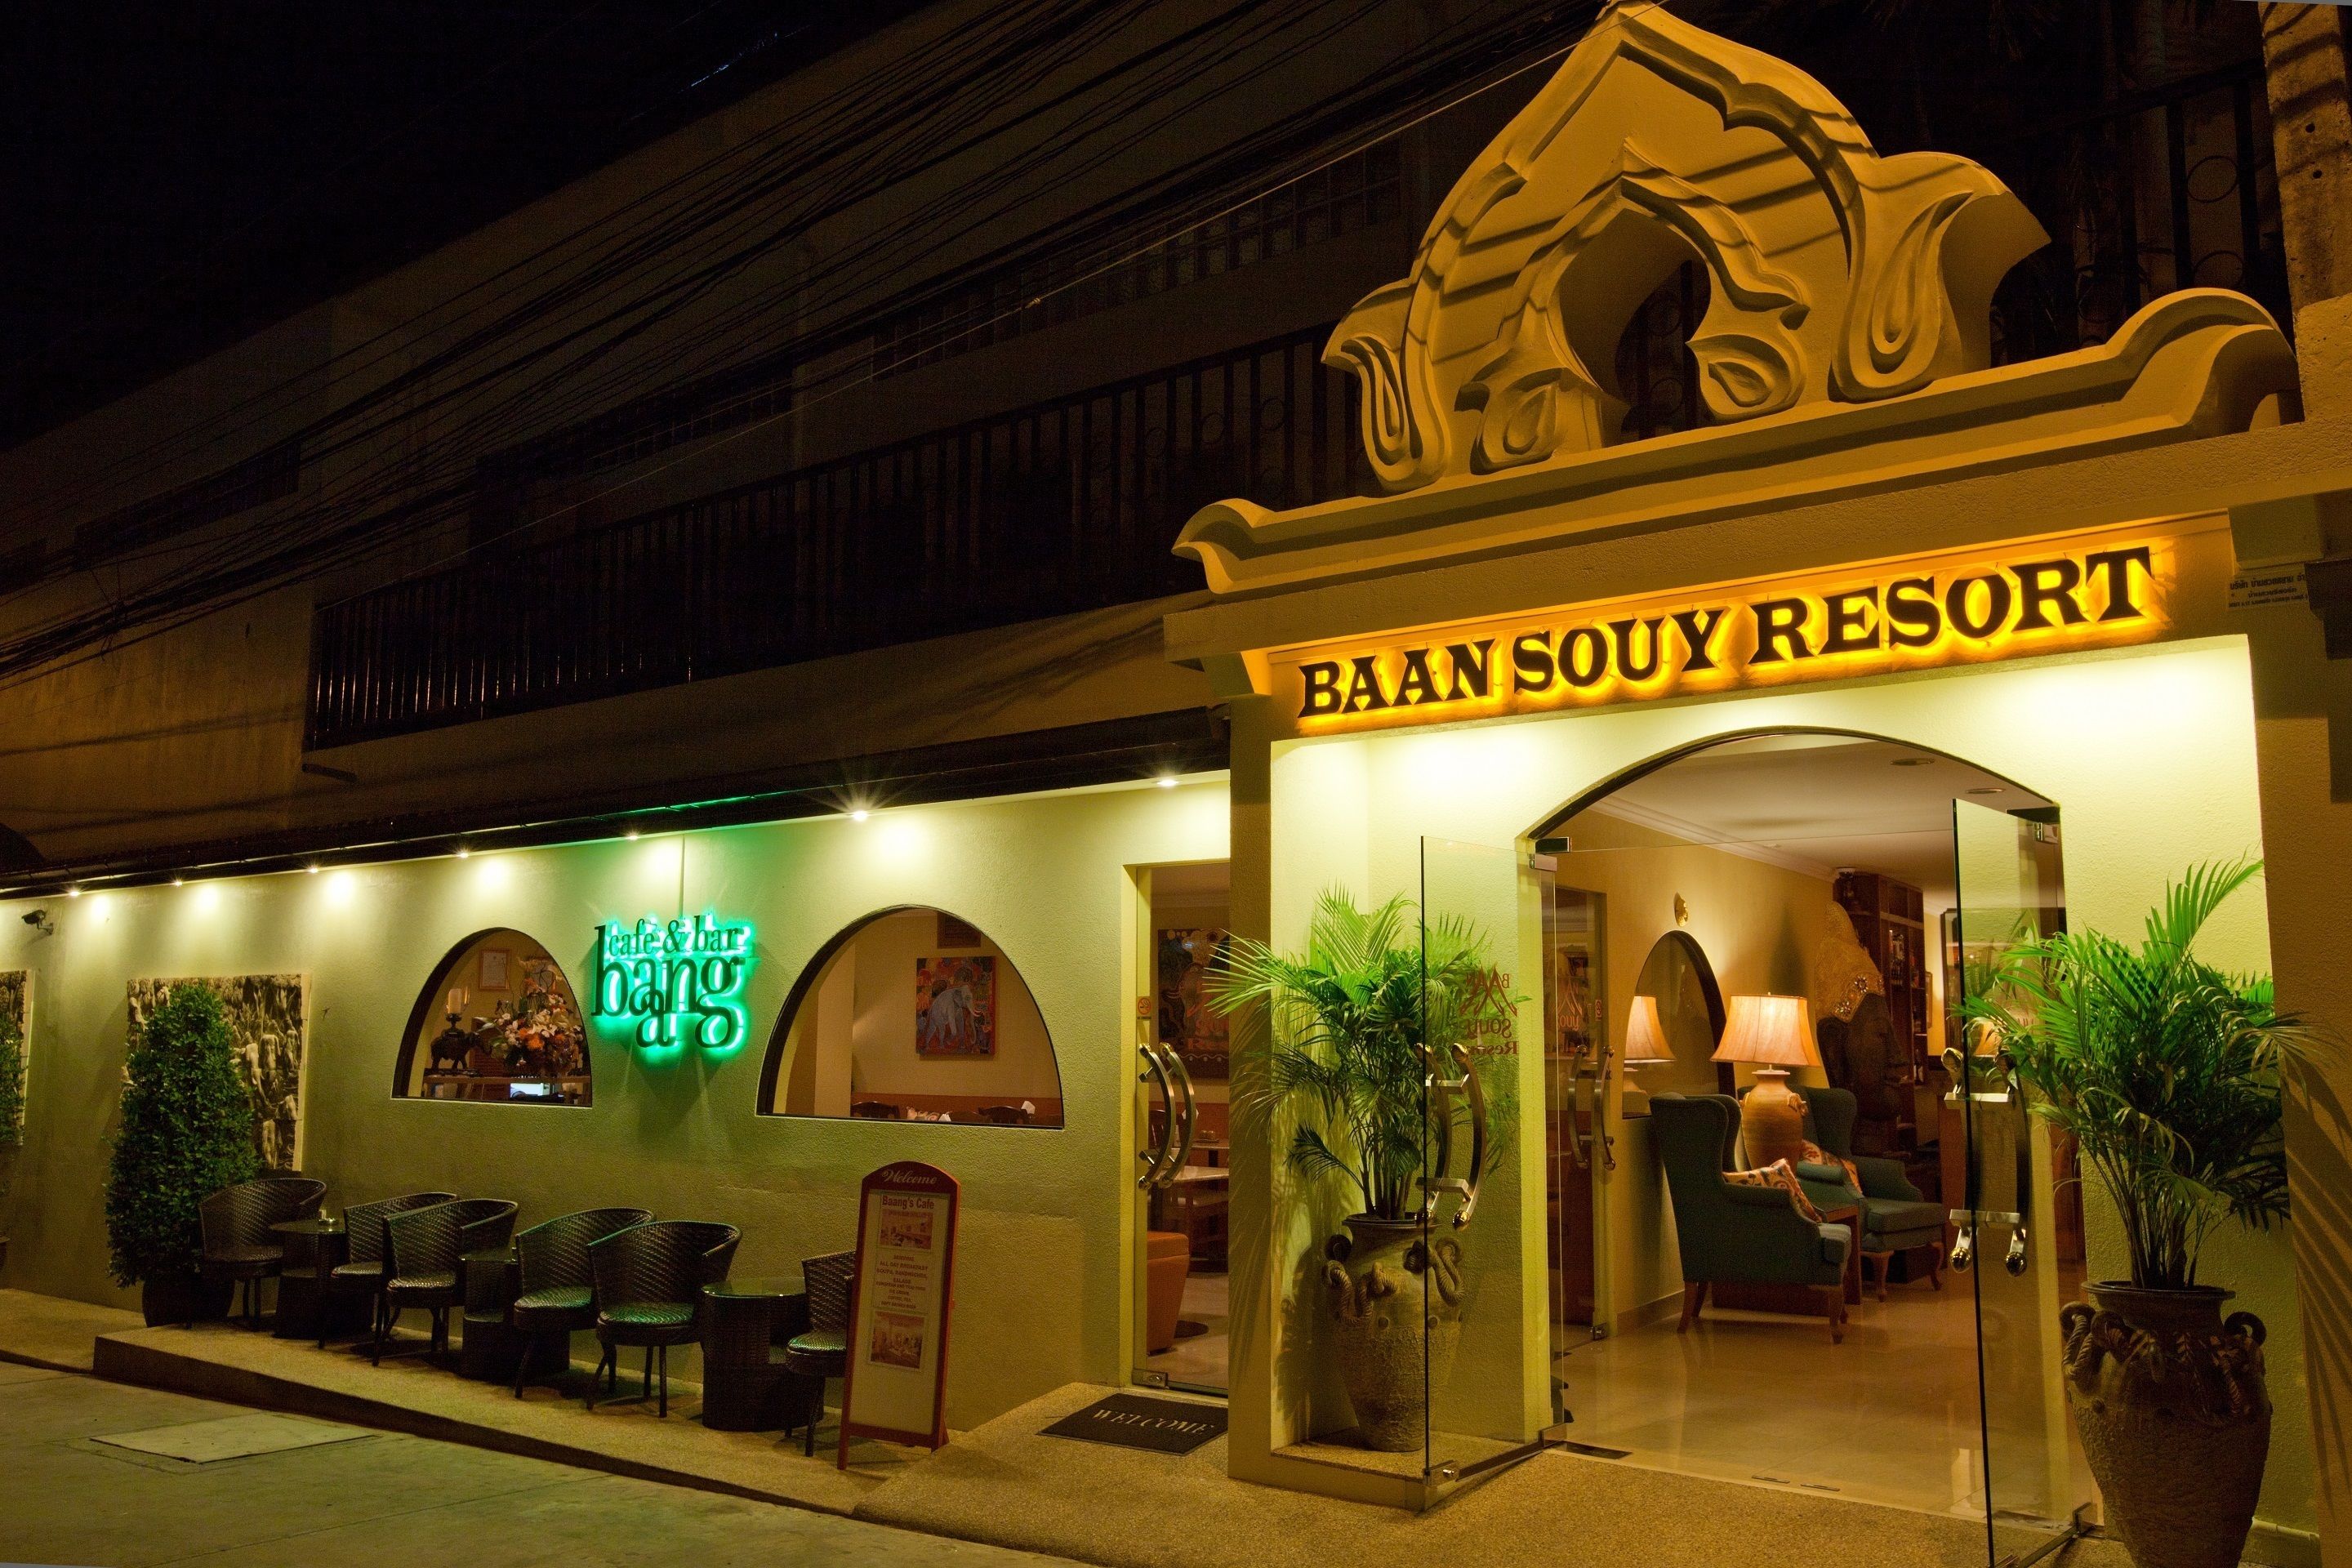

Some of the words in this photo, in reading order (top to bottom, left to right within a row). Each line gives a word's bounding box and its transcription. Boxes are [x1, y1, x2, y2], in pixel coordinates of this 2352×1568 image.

[1298, 638, 1496, 718] BAAN
[1512, 608, 1730, 693] SOUY
[1748, 546, 2154, 663] RESORT
[662, 920, 686, 953] &
[693, 915, 741, 951] bar
[881, 1169, 938, 1184] Welcome
[882, 1195, 914, 1210] Baang's
[916, 1197, 935, 1209] Cafe
[1092, 1409, 1214, 1434] WELCOME
